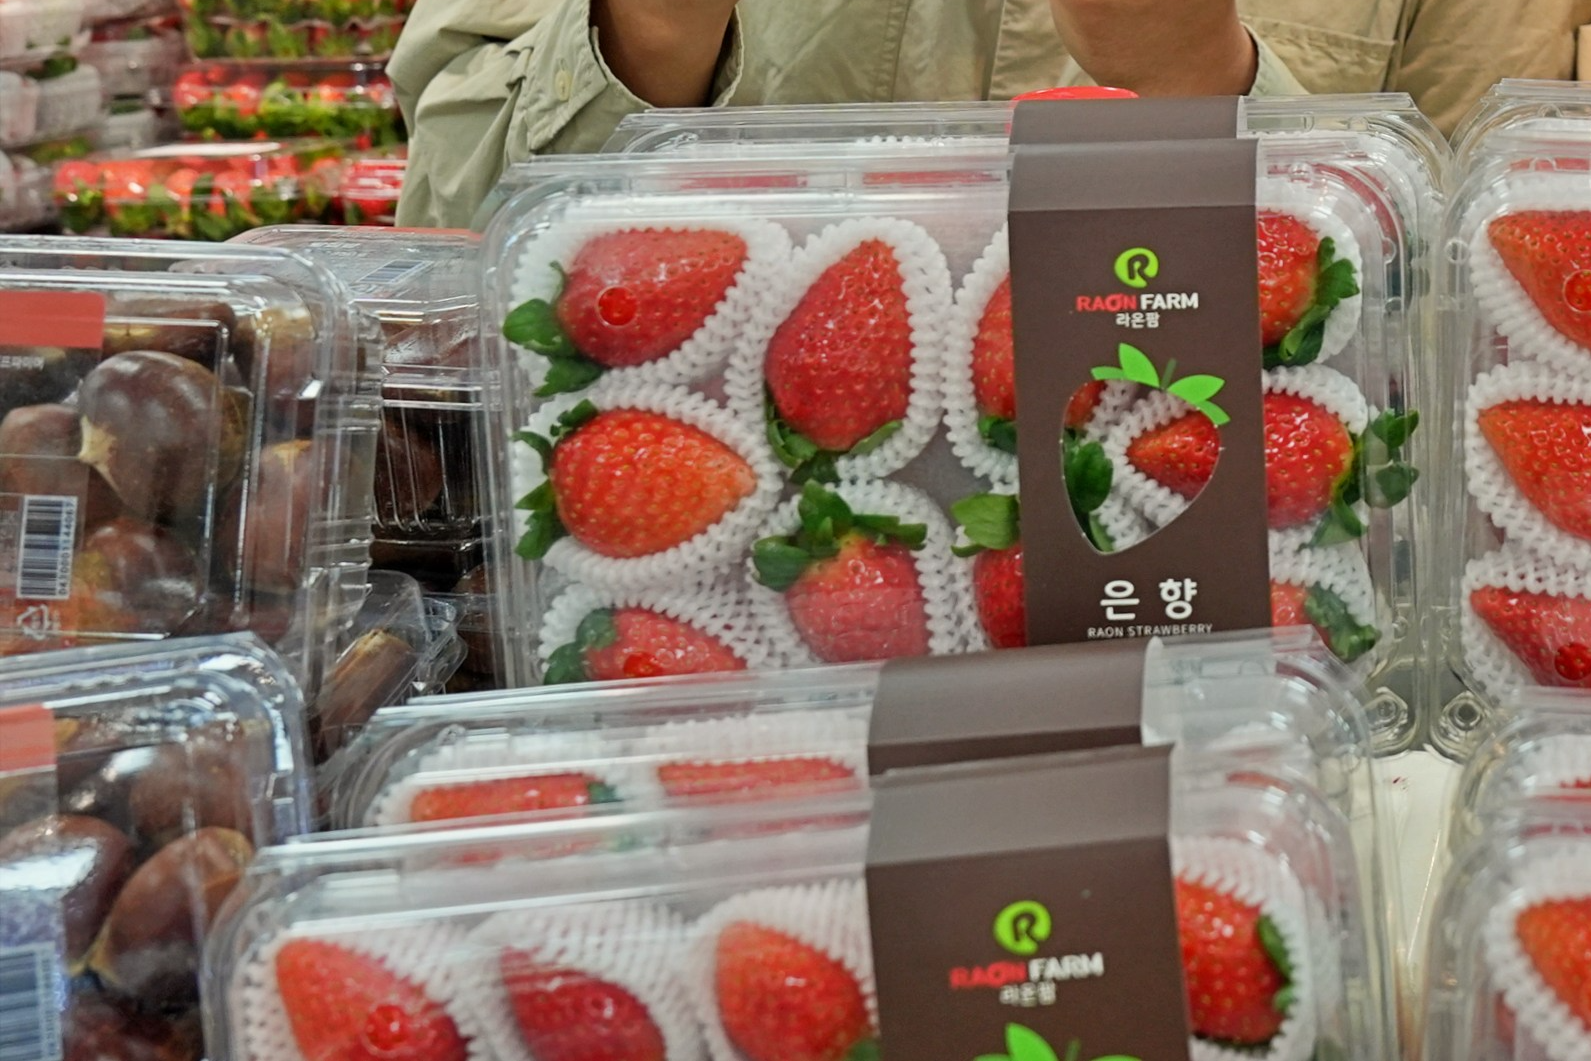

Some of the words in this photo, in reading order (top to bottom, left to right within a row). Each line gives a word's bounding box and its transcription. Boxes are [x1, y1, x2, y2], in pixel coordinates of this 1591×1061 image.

[1076, 293, 1137, 312] RAON
[1140, 292, 1199, 310] FARM
[1115, 312, 1160, 328] 라온팜
[1087, 626, 1124, 638] RAON
[1127, 623, 1214, 637] STRAWBERRY
[1028, 952, 1105, 982] FARM
